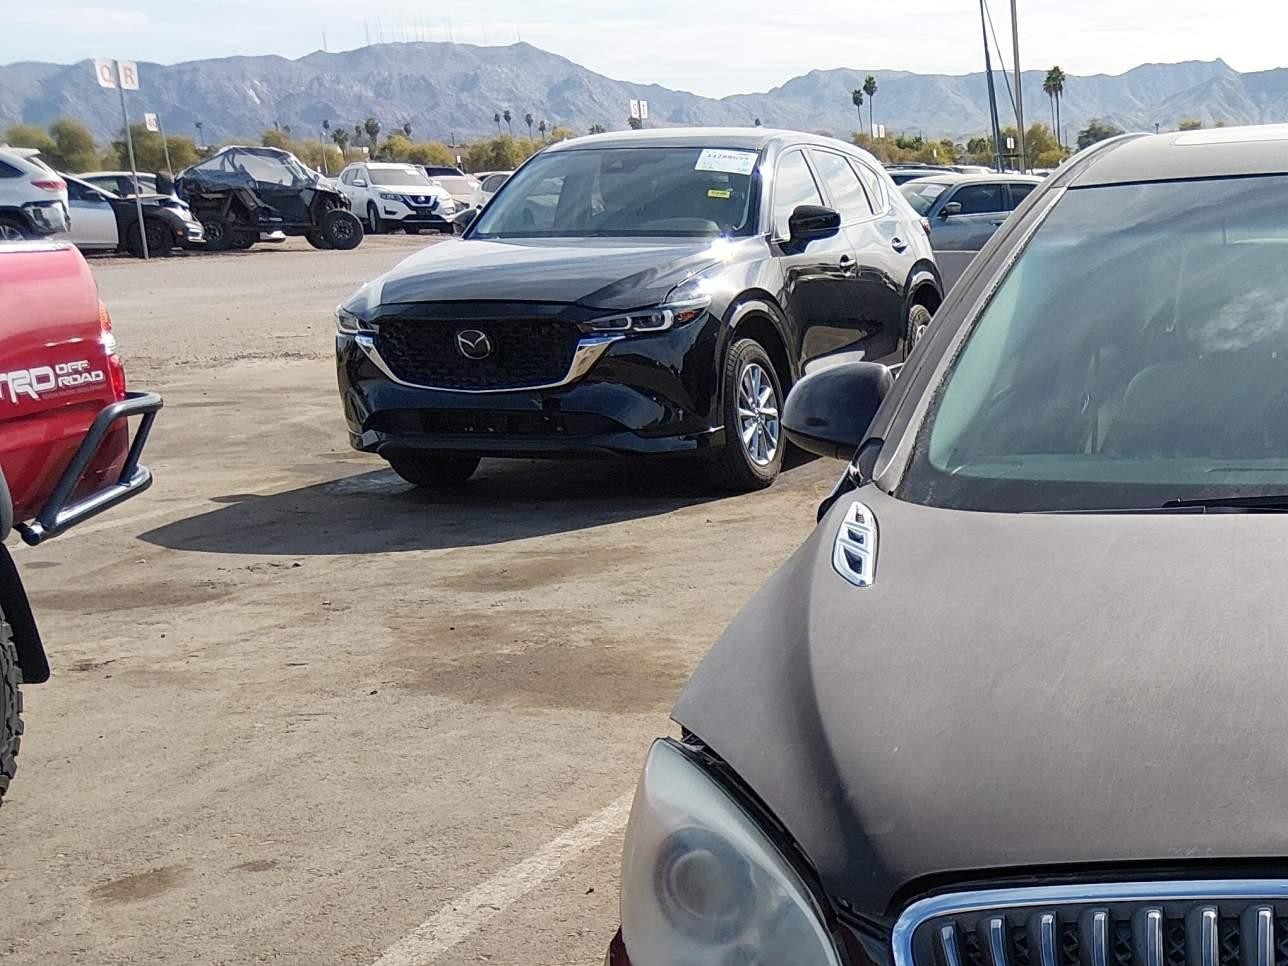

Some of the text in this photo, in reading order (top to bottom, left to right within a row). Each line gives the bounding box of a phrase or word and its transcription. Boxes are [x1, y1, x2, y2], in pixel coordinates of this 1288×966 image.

[123, 65, 135, 85] R
[55, 360, 89, 374] OFF
[58, 371, 104, 387] ROAD
